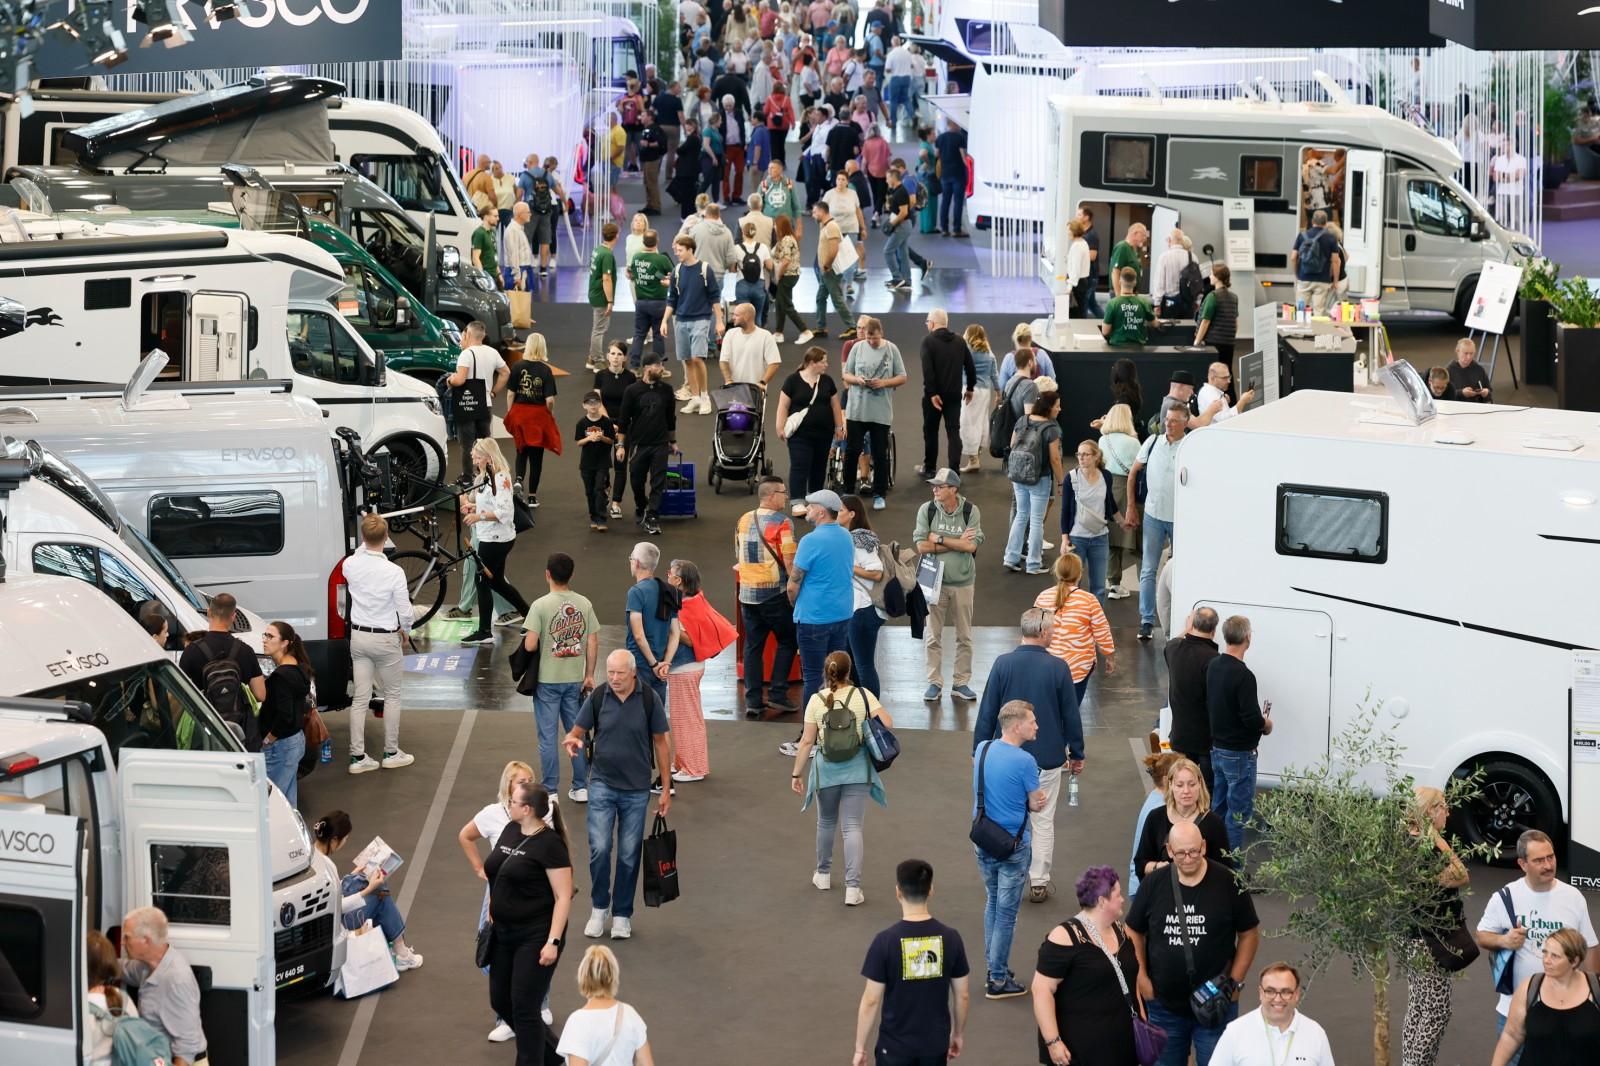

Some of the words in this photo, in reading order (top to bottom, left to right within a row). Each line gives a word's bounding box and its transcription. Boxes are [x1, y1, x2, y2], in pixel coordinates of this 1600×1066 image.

[634, 260, 651, 268] Enjoy
[1121, 303, 1139, 311] Enjoy
[221, 447, 296, 462] ETRVSCO
[0, 829, 55, 854] VSCO
[1165, 914, 1206, 924] MARIED
[1516, 912, 1563, 930] Urban
[1163, 926, 1182, 935] AND
[1526, 928, 1553, 941] Class
[1168, 937, 1200, 946] HAPY
[275, 971, 285, 982] CV
[284, 967, 296, 978] 640
[296, 964, 305, 974] SB
